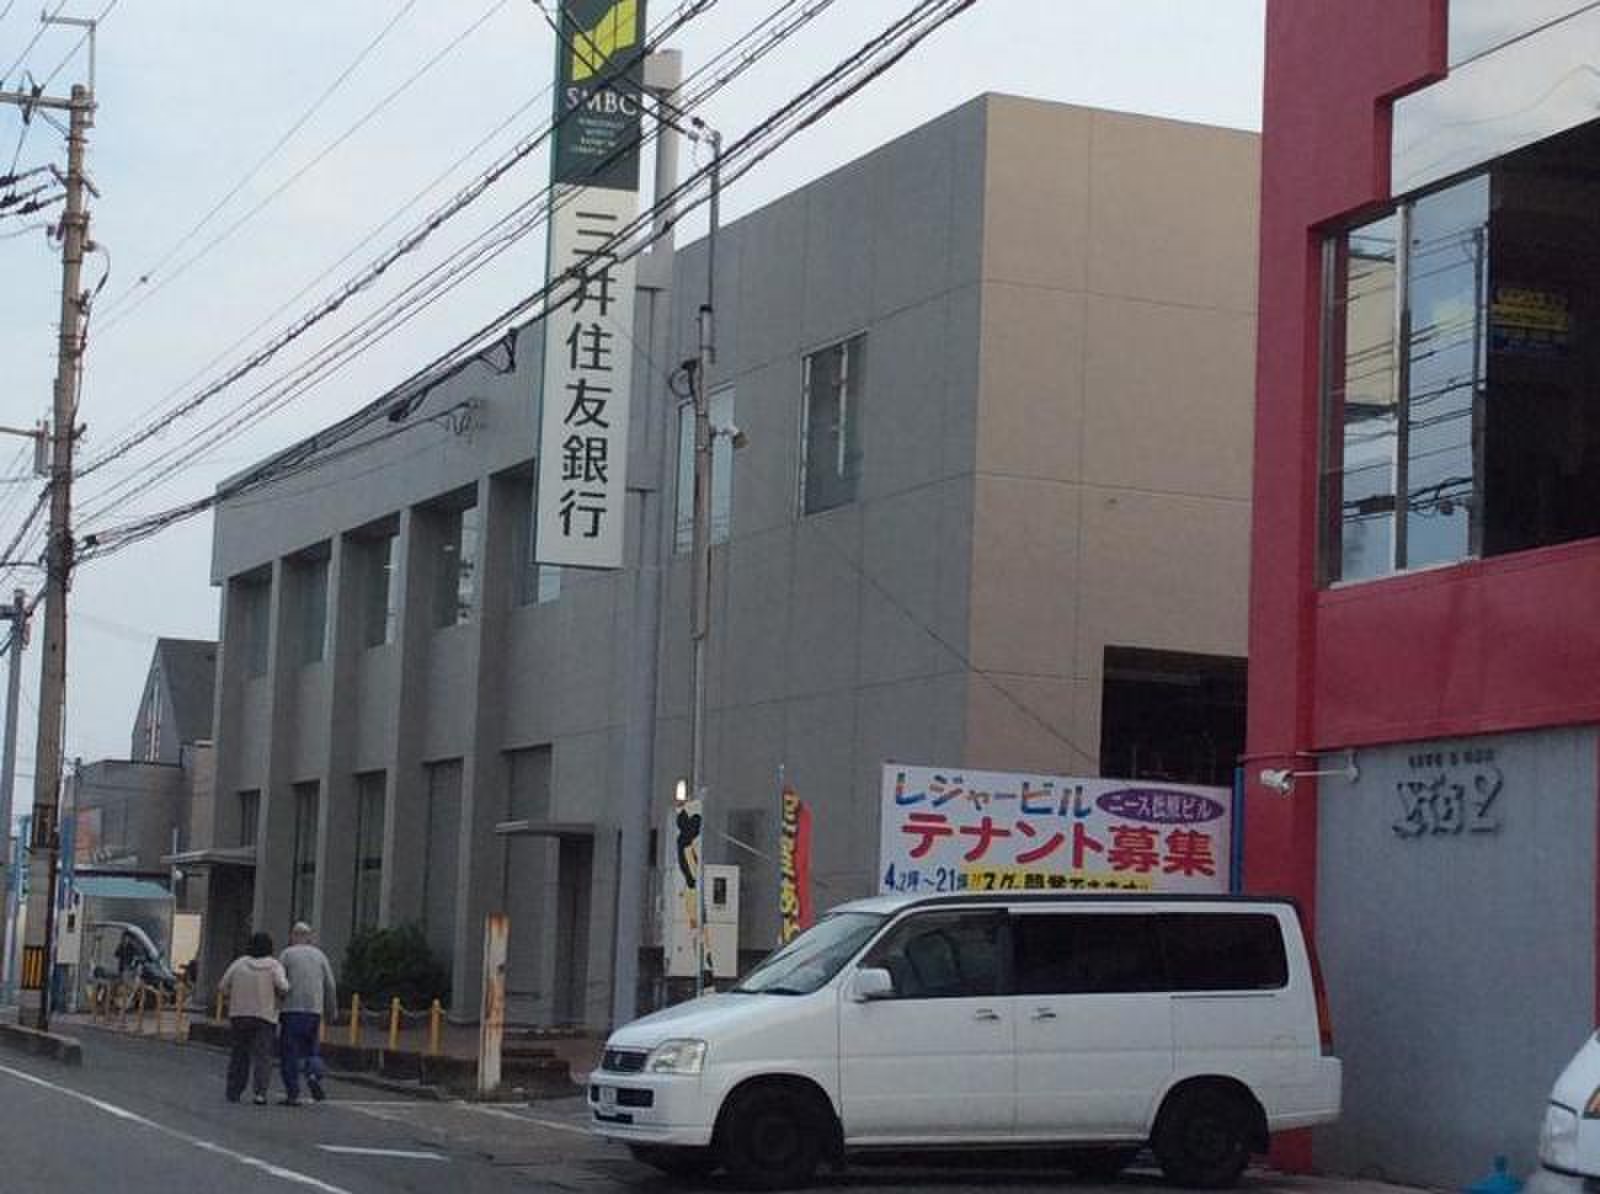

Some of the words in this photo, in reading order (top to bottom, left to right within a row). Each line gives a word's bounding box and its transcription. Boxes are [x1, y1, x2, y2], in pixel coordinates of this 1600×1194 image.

[565, 86, 637, 115] SMBC
[559, 210, 618, 538] 三井住友銀行
[895, 773, 1092, 817] レジャービル
[901, 812, 1215, 877] テナント募集
